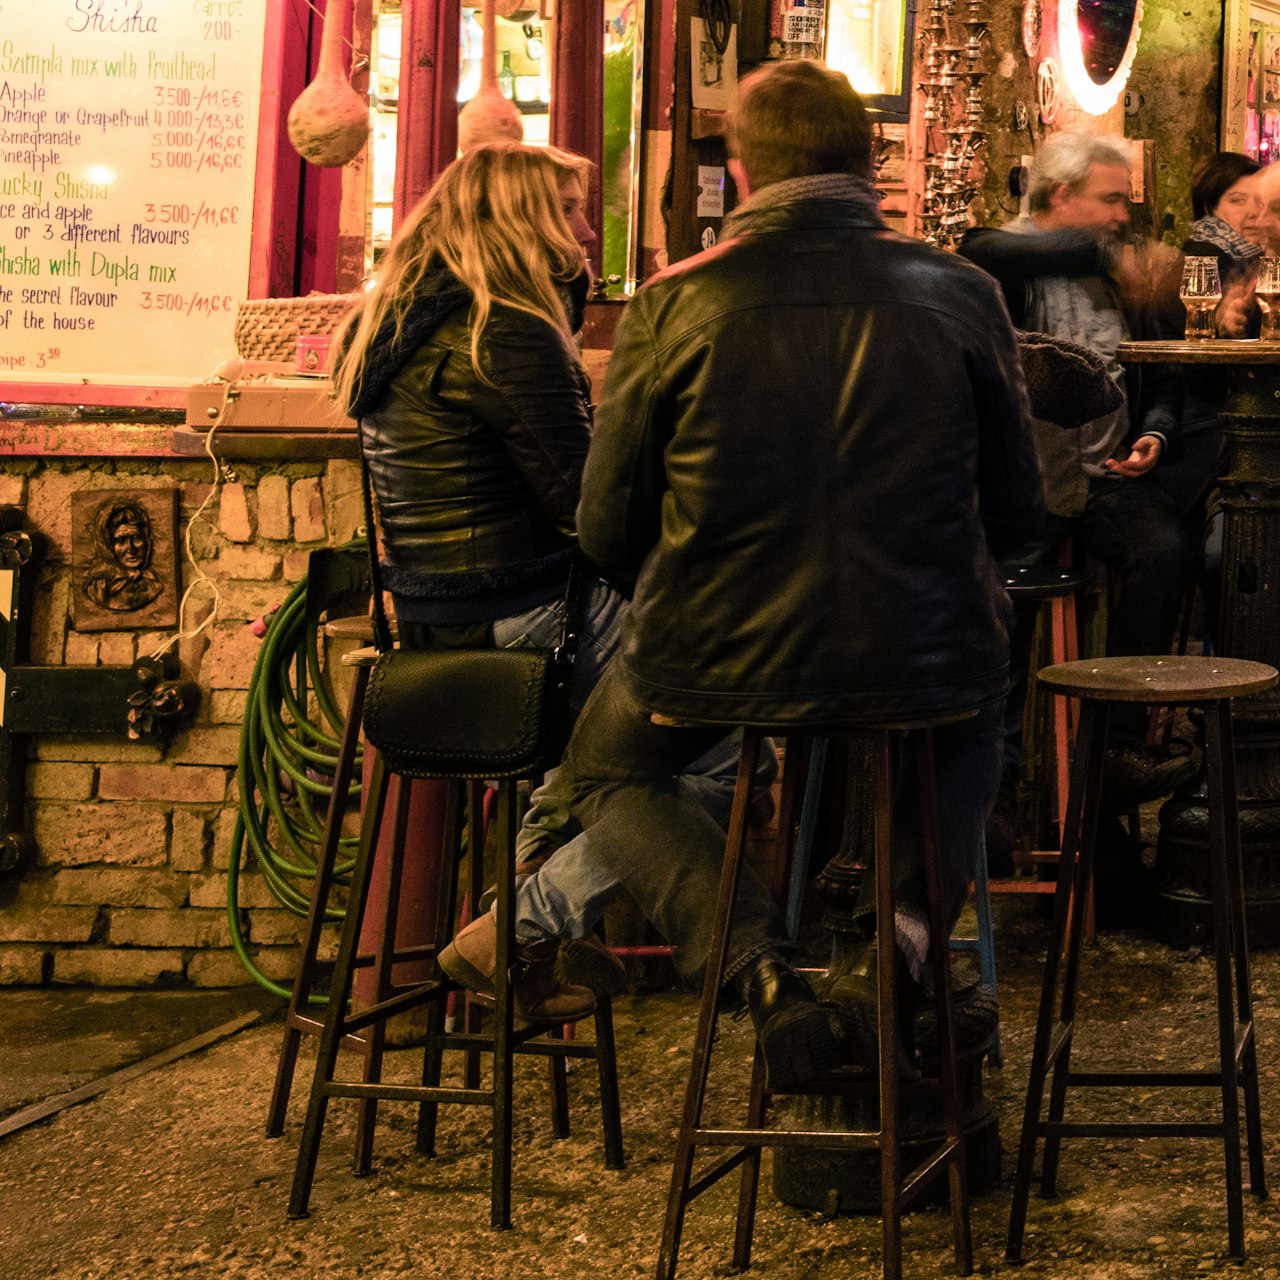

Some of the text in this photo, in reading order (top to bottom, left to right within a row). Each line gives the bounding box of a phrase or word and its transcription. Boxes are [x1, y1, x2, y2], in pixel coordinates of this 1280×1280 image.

[1, 39, 217, 86] Szimpla mix with fruithead
[0, 81, 46, 109] Apple
[55, 108, 70, 123] or
[76, 107, 151, 134] Grapefruit
[21, 201, 50, 220] and
[54, 203, 93, 229] apple
[15, 223, 190, 250] or 3 different flavours
[49, 248, 81, 278] with
[91, 251, 139, 287] Dupla
[149, 263, 177, 284] mix
[21, 285, 61, 306] secret
[70, 285, 118, 308] flavour
[23, 310, 45, 330] the
[53, 311, 95, 331] house
